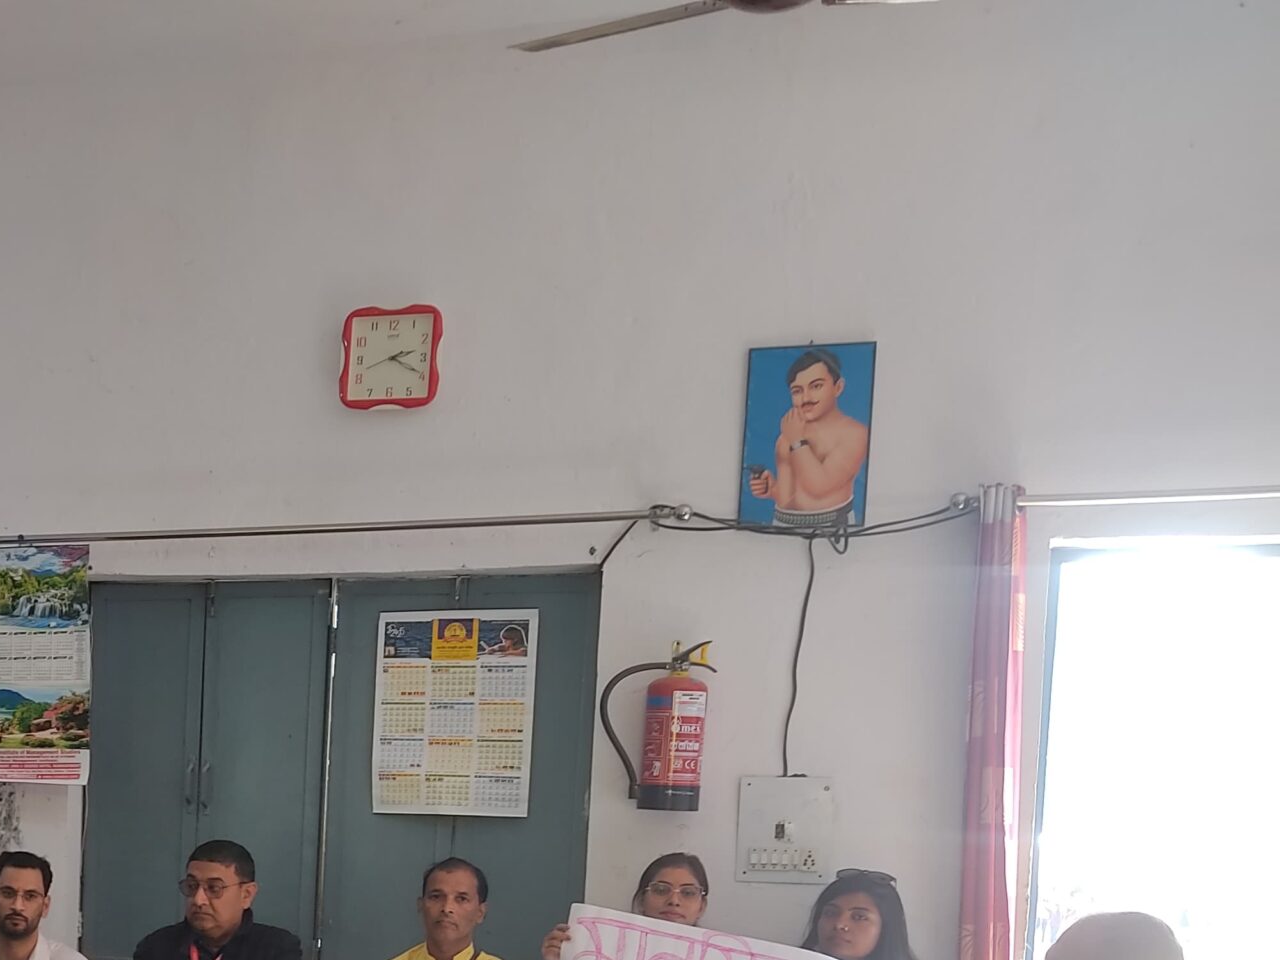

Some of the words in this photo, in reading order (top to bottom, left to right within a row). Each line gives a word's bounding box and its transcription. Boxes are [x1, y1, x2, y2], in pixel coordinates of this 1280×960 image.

[371, 321, 379, 331] 11
[388, 320, 400, 331] 12
[412, 319, 417, 329] 1
[356, 336, 367, 348] 10
[421, 333, 429, 345] 2
[356, 355, 364, 365] 9
[420, 352, 427, 363] 3
[355, 374, 363, 385] 8
[367, 388, 373, 398] 7
[385, 387, 393, 397] 6
[406, 386, 412, 397] 5
